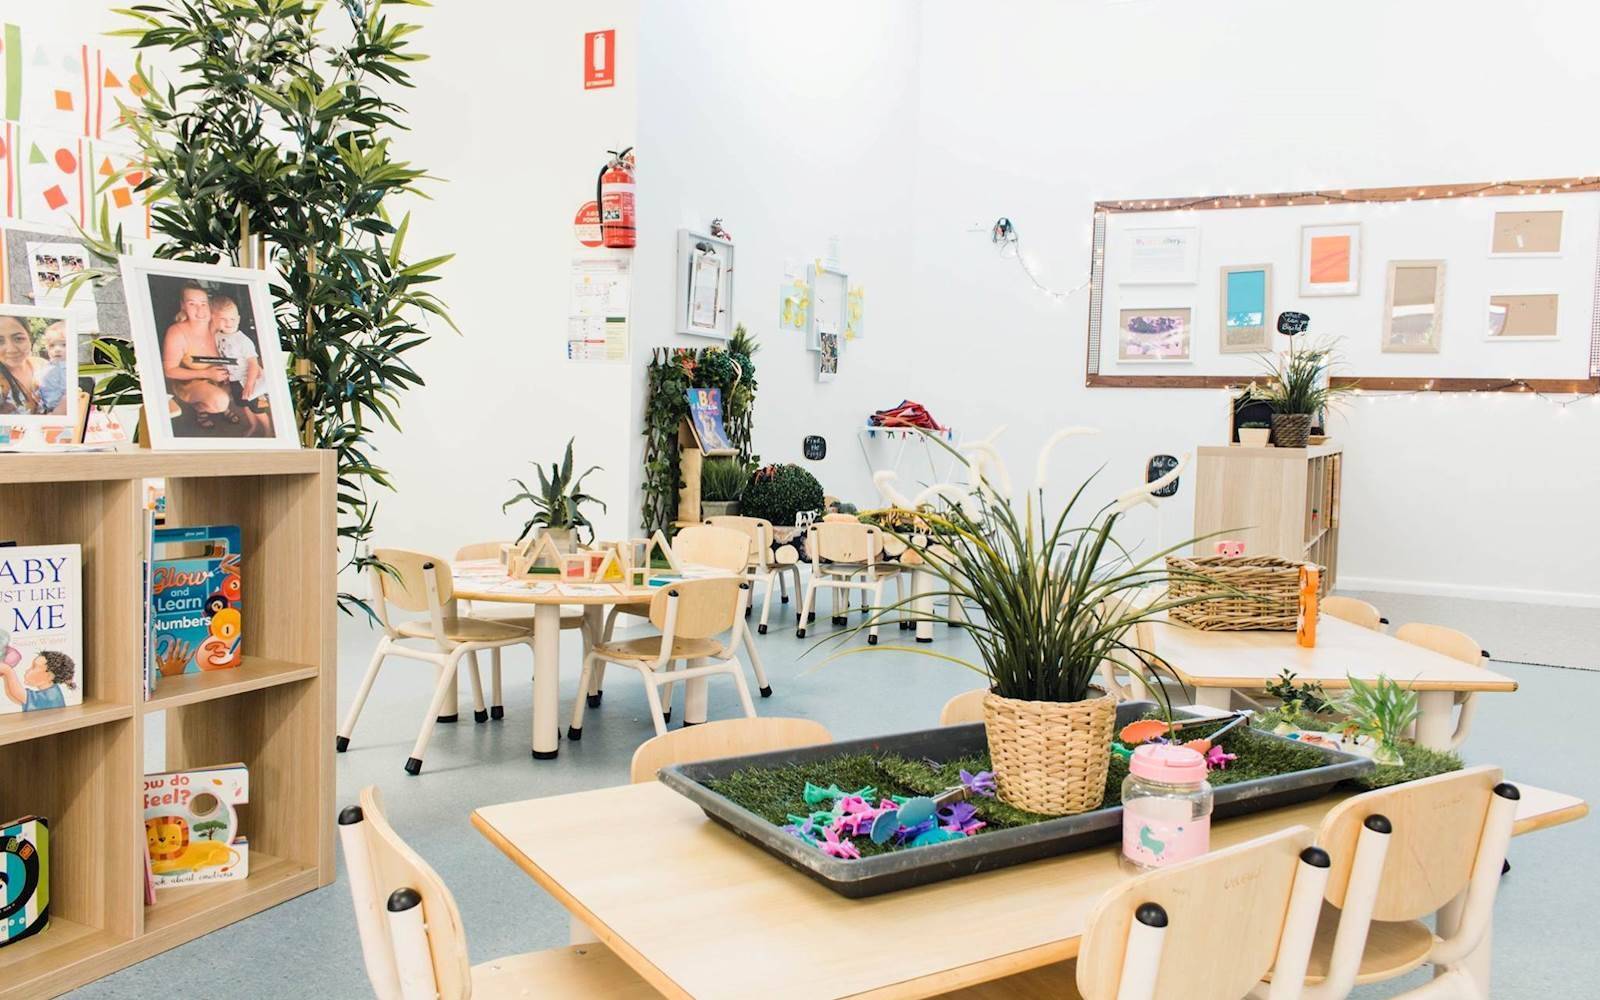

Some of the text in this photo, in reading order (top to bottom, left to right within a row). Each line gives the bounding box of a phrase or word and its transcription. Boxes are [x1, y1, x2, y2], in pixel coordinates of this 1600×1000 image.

[153, 567, 209, 595] Glow
[31, 586, 66, 601] LIKE
[170, 587, 189, 597] and
[157, 597, 202, 612] Learn
[12, 604, 66, 632] ME
[155, 615, 212, 631] Numbers
[170, 774, 190, 786] do
[144, 789, 191, 810] feel?
